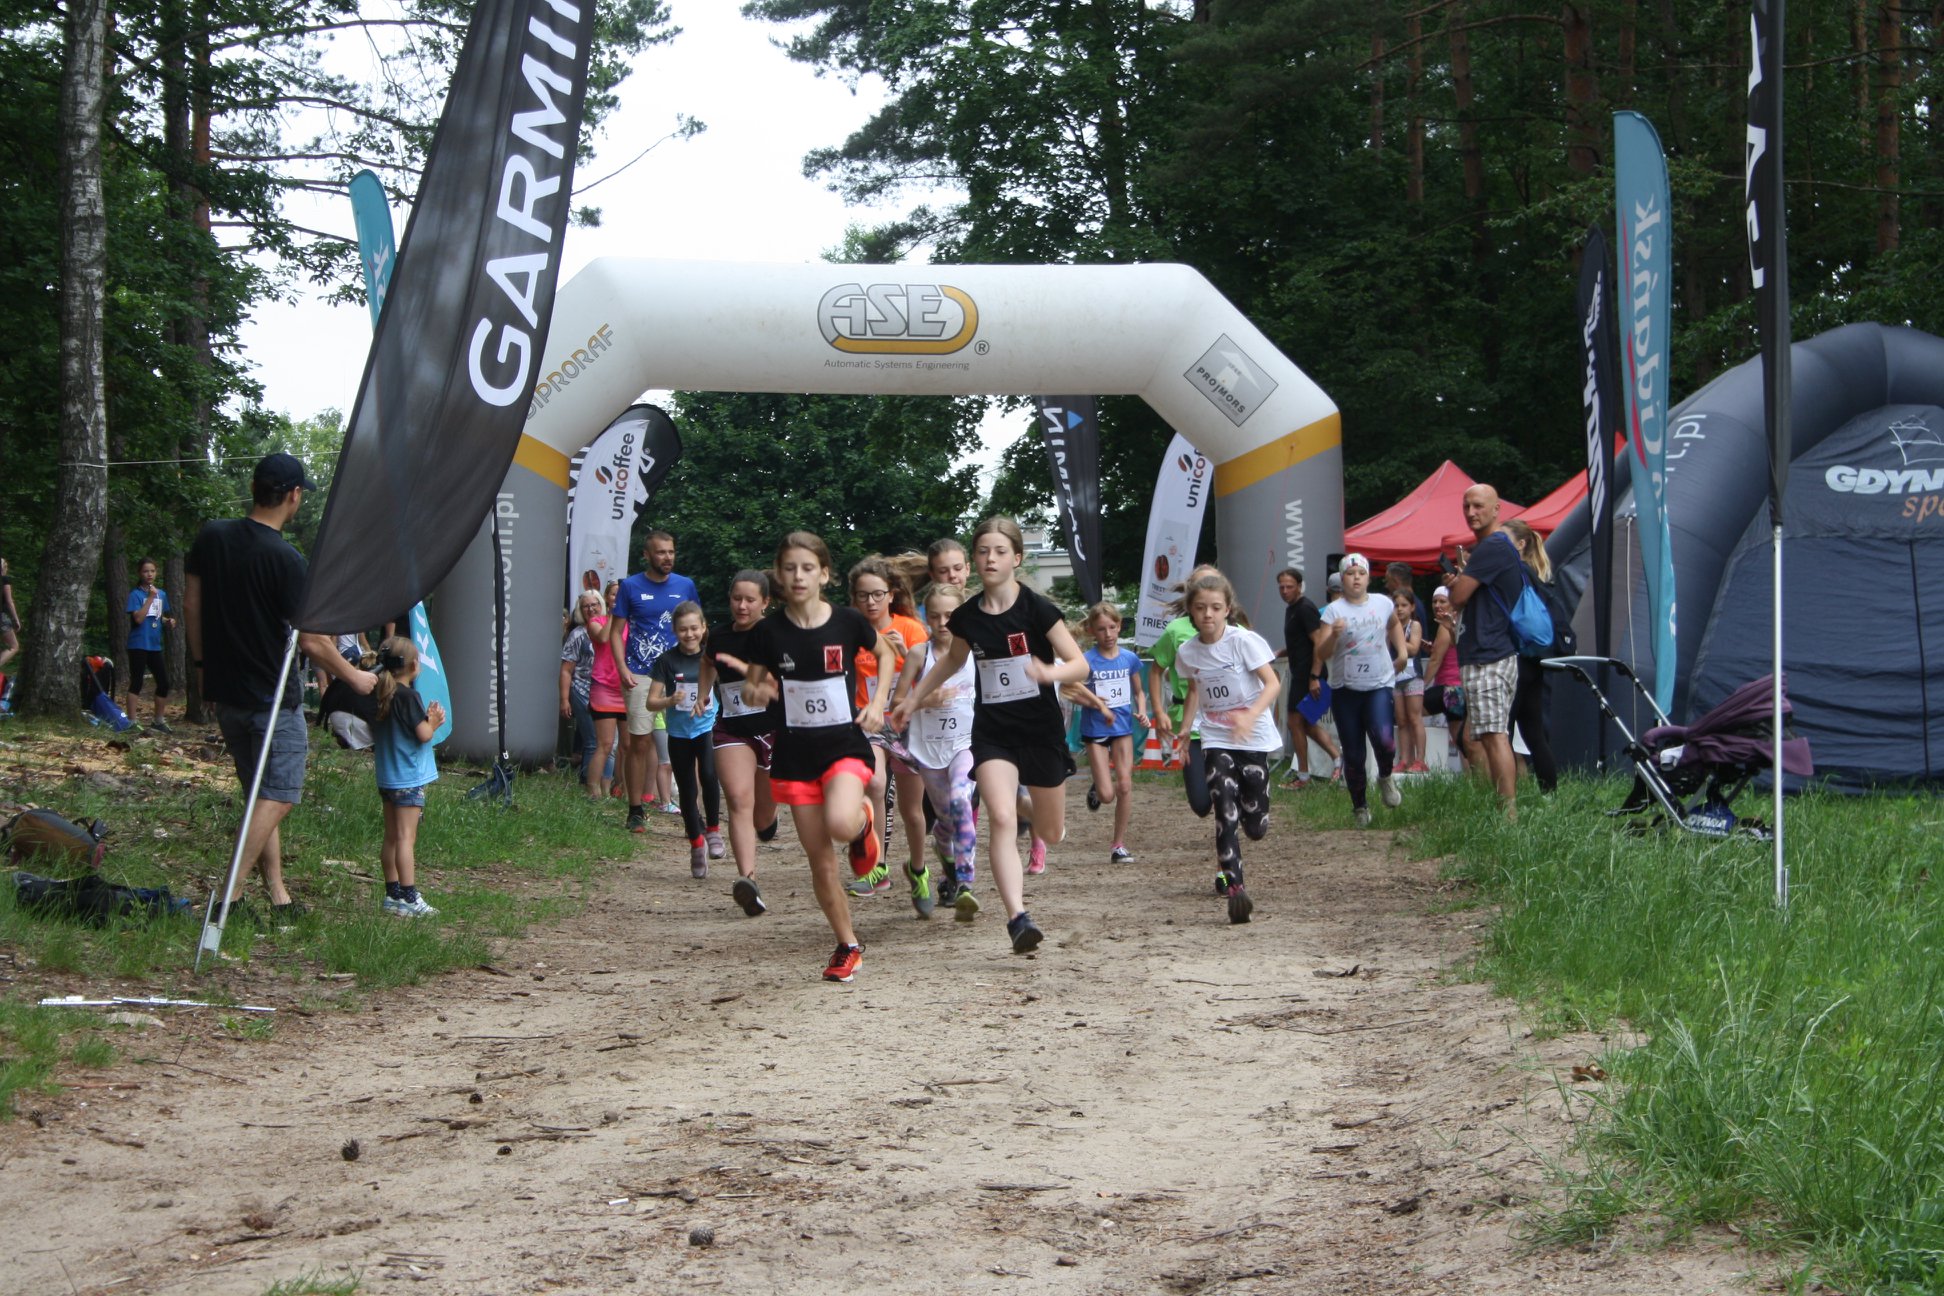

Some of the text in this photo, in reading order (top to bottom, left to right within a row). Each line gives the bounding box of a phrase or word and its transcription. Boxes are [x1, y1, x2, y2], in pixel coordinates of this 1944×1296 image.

[817, 283, 947, 343] ASE
[824, 359, 970, 371] Automatic Systems Engineering
[1196, 366, 1246, 414] PROJMORS
[611, 432, 635, 521] unicoffee
[1092, 668, 1130, 680] ACTIVE
[1356, 663, 1370, 673] 72
[999, 672, 1010, 687] 6
[1110, 687, 1122, 699] 34
[1206, 685, 1230, 700] 100
[805, 698, 828, 714] 63
[938, 717, 957, 731] 73
